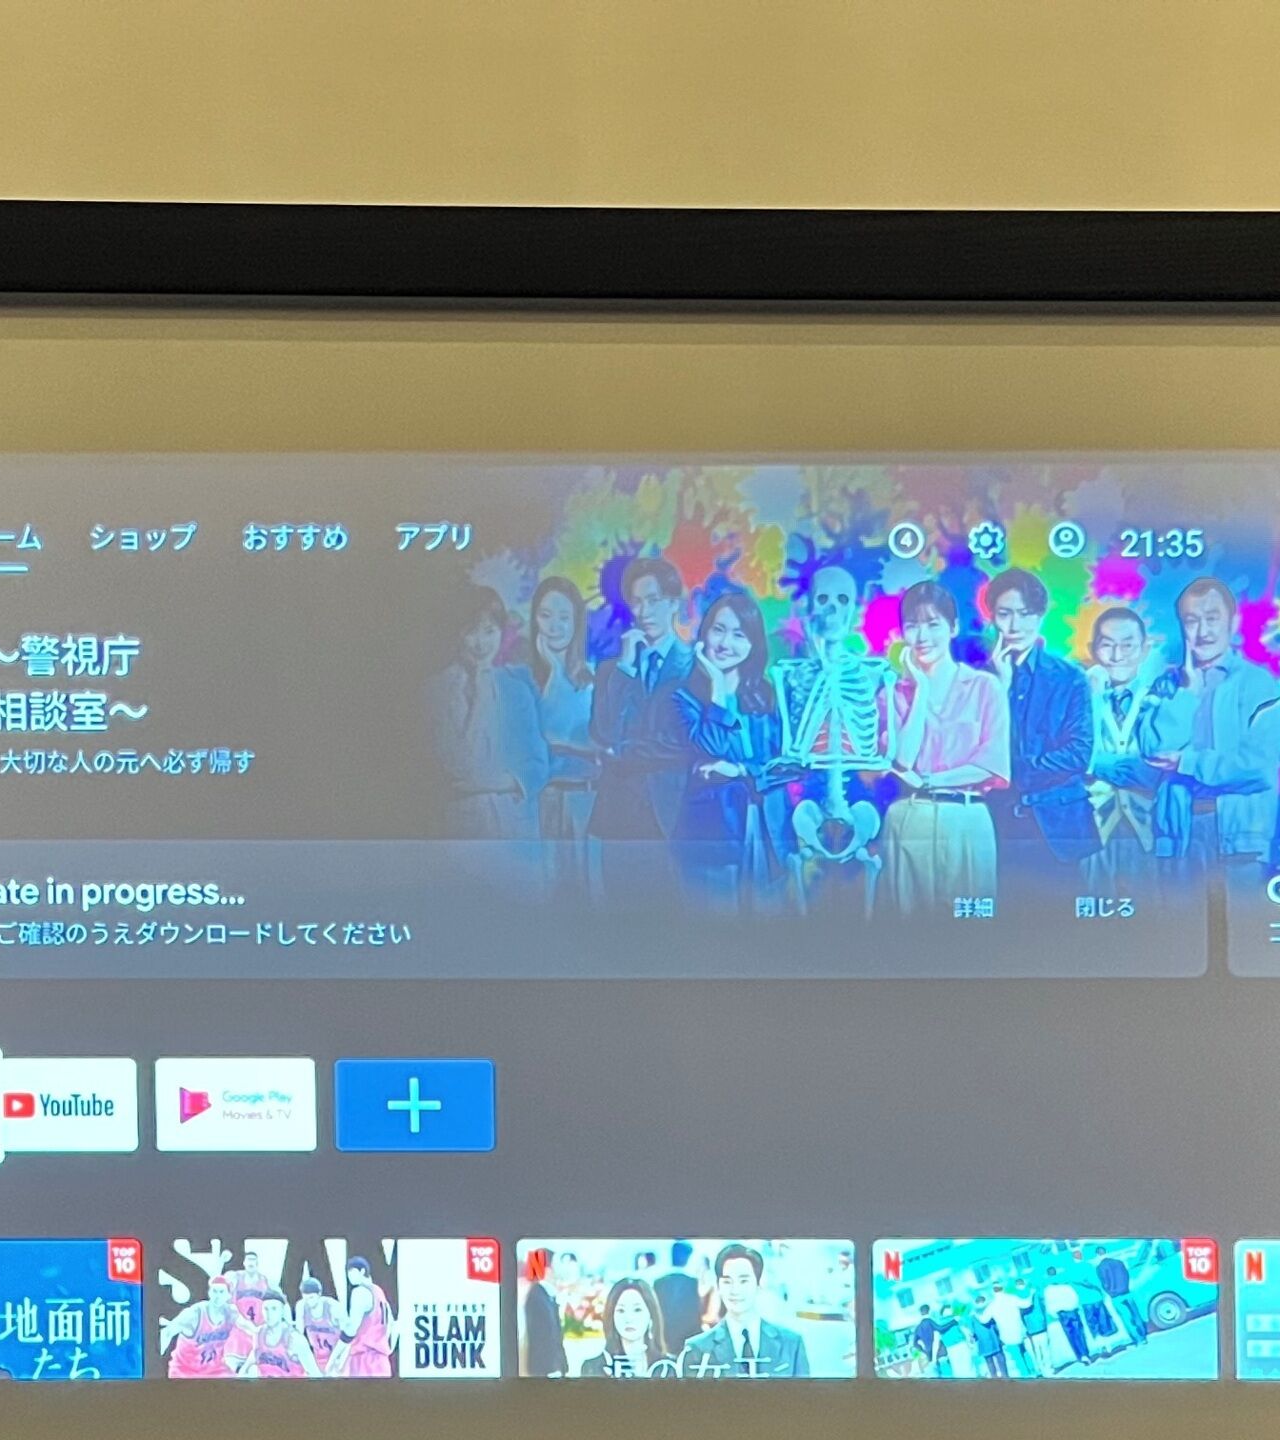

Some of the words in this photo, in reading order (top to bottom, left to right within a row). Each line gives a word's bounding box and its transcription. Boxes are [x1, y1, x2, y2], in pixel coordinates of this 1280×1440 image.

[90, 523, 197, 551] ショップ
[243, 523, 348, 551] おすすめ
[395, 523, 473, 551] アプリ
[1120, 529, 1204, 558] 21:35
[47, 877, 76, 905] in
[81, 879, 246, 912] progress...
[953, 896, 994, 918] 詳細
[1075, 896, 1135, 918] 閉じる
[39, 1093, 115, 1117] YouTube
[222, 1089, 265, 1106] Google
[276, 1108, 292, 1120] TV
[111, 1246, 136, 1257] TOP
[470, 1246, 494, 1256] TOP
[1186, 1246, 1211, 1257] TOP
[114, 1257, 136, 1274] 10
[472, 1256, 494, 1273] 10
[527, 1249, 548, 1282] N
[884, 1250, 900, 1281] N
[1189, 1257, 1211, 1273] 10
[1245, 1250, 1263, 1281] N
[413, 1315, 486, 1342] SLAM
[32, 1347, 101, 1379] たち
[415, 1342, 487, 1369] DUNK
